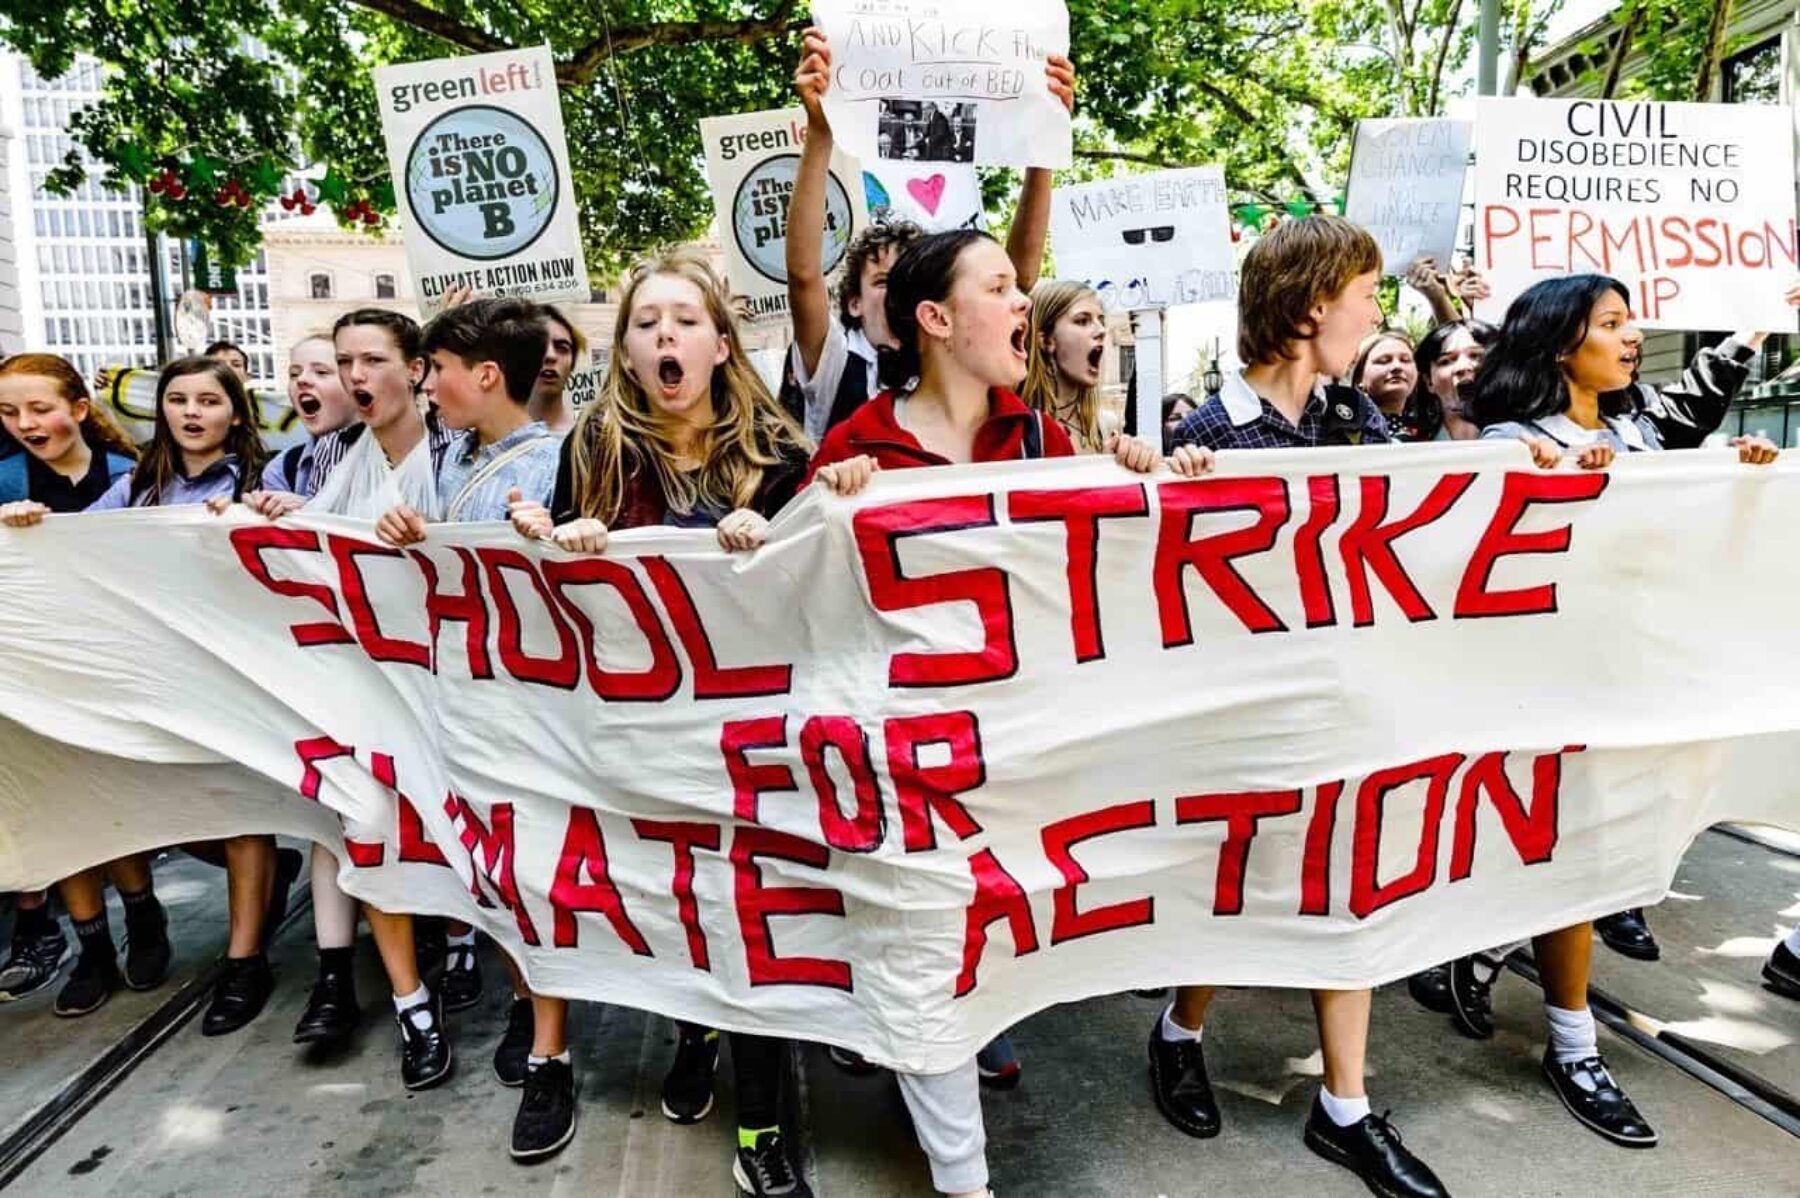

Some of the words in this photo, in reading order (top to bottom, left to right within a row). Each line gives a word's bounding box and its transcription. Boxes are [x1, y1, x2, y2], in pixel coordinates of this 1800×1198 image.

[907, 17, 1000, 60] KICK
[391, 74, 477, 113] green
[479, 63, 532, 95] left
[986, 68, 1025, 94] BED
[1566, 101, 1678, 138] CIVIL
[436, 133, 506, 152] There
[719, 128, 790, 160] green
[1518, 139, 1740, 168] DISOBEDIENCE
[463, 146, 527, 184] NO
[431, 172, 539, 214] planet
[757, 178, 794, 195] The
[1506, 173, 1661, 203] REQUIRES
[1691, 178, 1739, 203] NO
[479, 202, 516, 239] B
[1069, 183, 1145, 230] MAKE
[1484, 204, 1797, 274] PERMISSION
[421, 269, 484, 297] CLIMATE
[487, 262, 538, 288] ACTION
[540, 256, 576, 281] NOW
[229, 525, 793, 703] SCHOOL
[852, 471, 1609, 690] STRIKE
[720, 710, 987, 853] FOR
[953, 743, 1587, 998] ACTION
